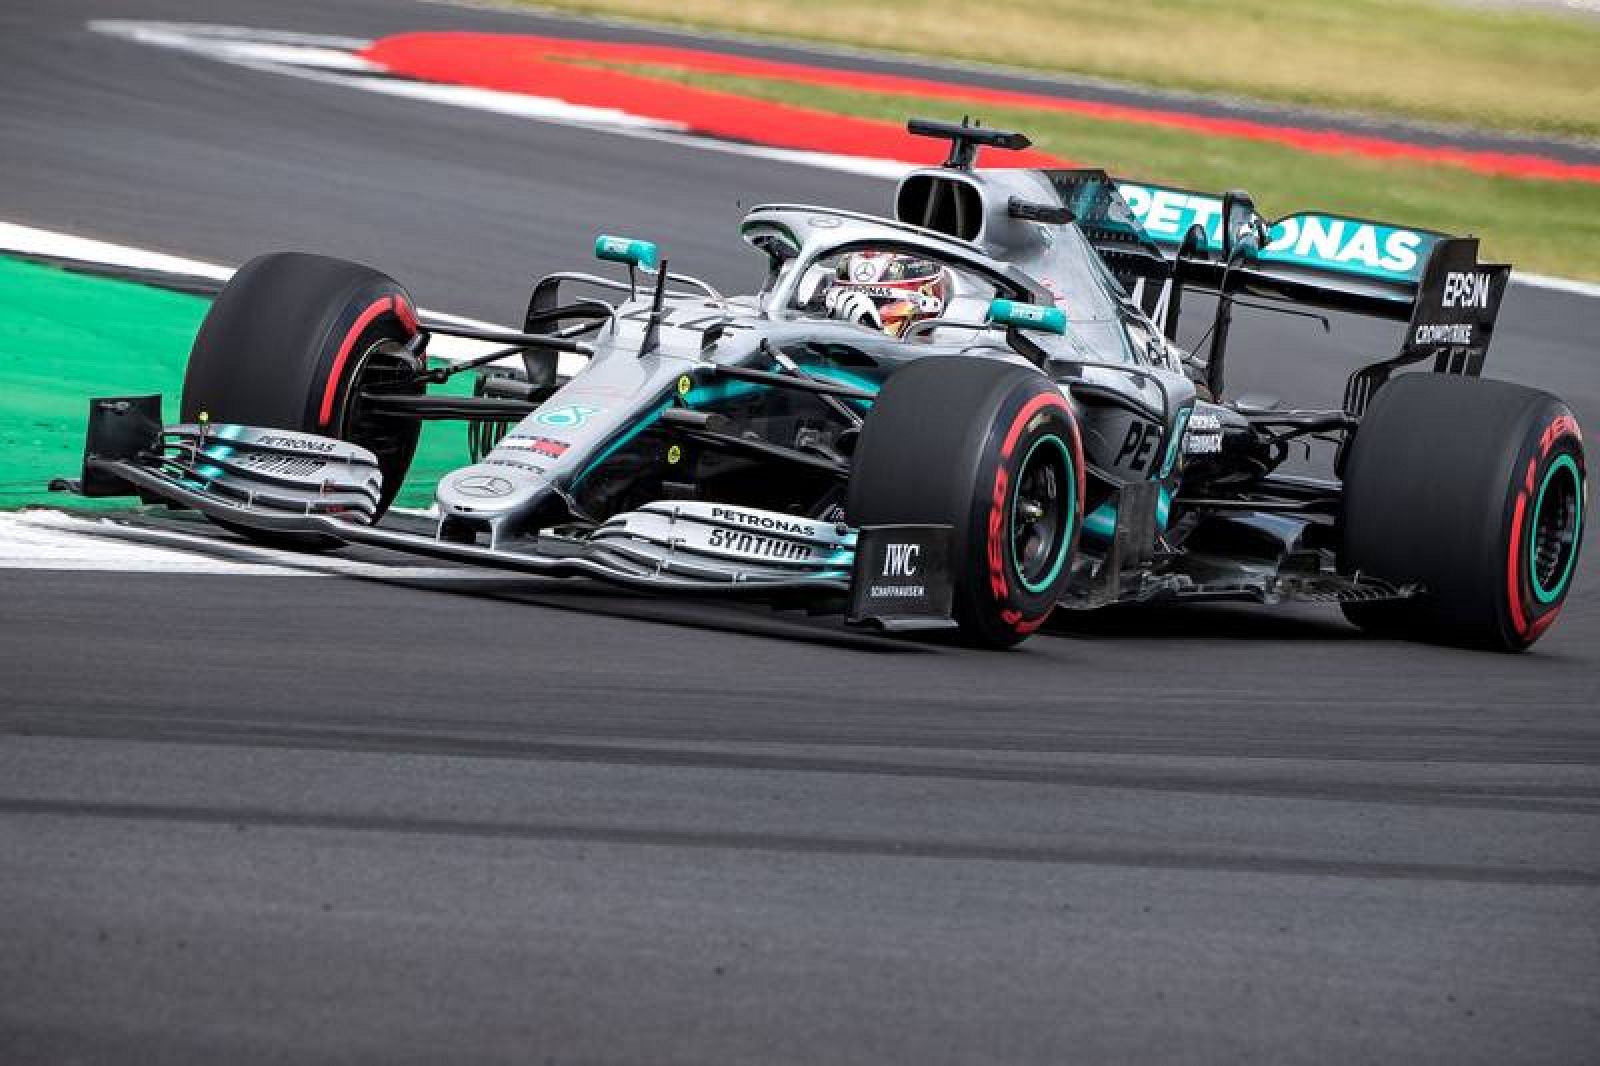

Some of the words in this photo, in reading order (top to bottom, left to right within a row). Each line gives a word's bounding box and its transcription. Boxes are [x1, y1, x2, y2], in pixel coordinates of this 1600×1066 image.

[1109, 184, 1421, 271] PETONAS
[711, 507, 815, 536] PETRONAS
[708, 529, 812, 560] SYNTIUM
[882, 543, 920, 577] IWC
